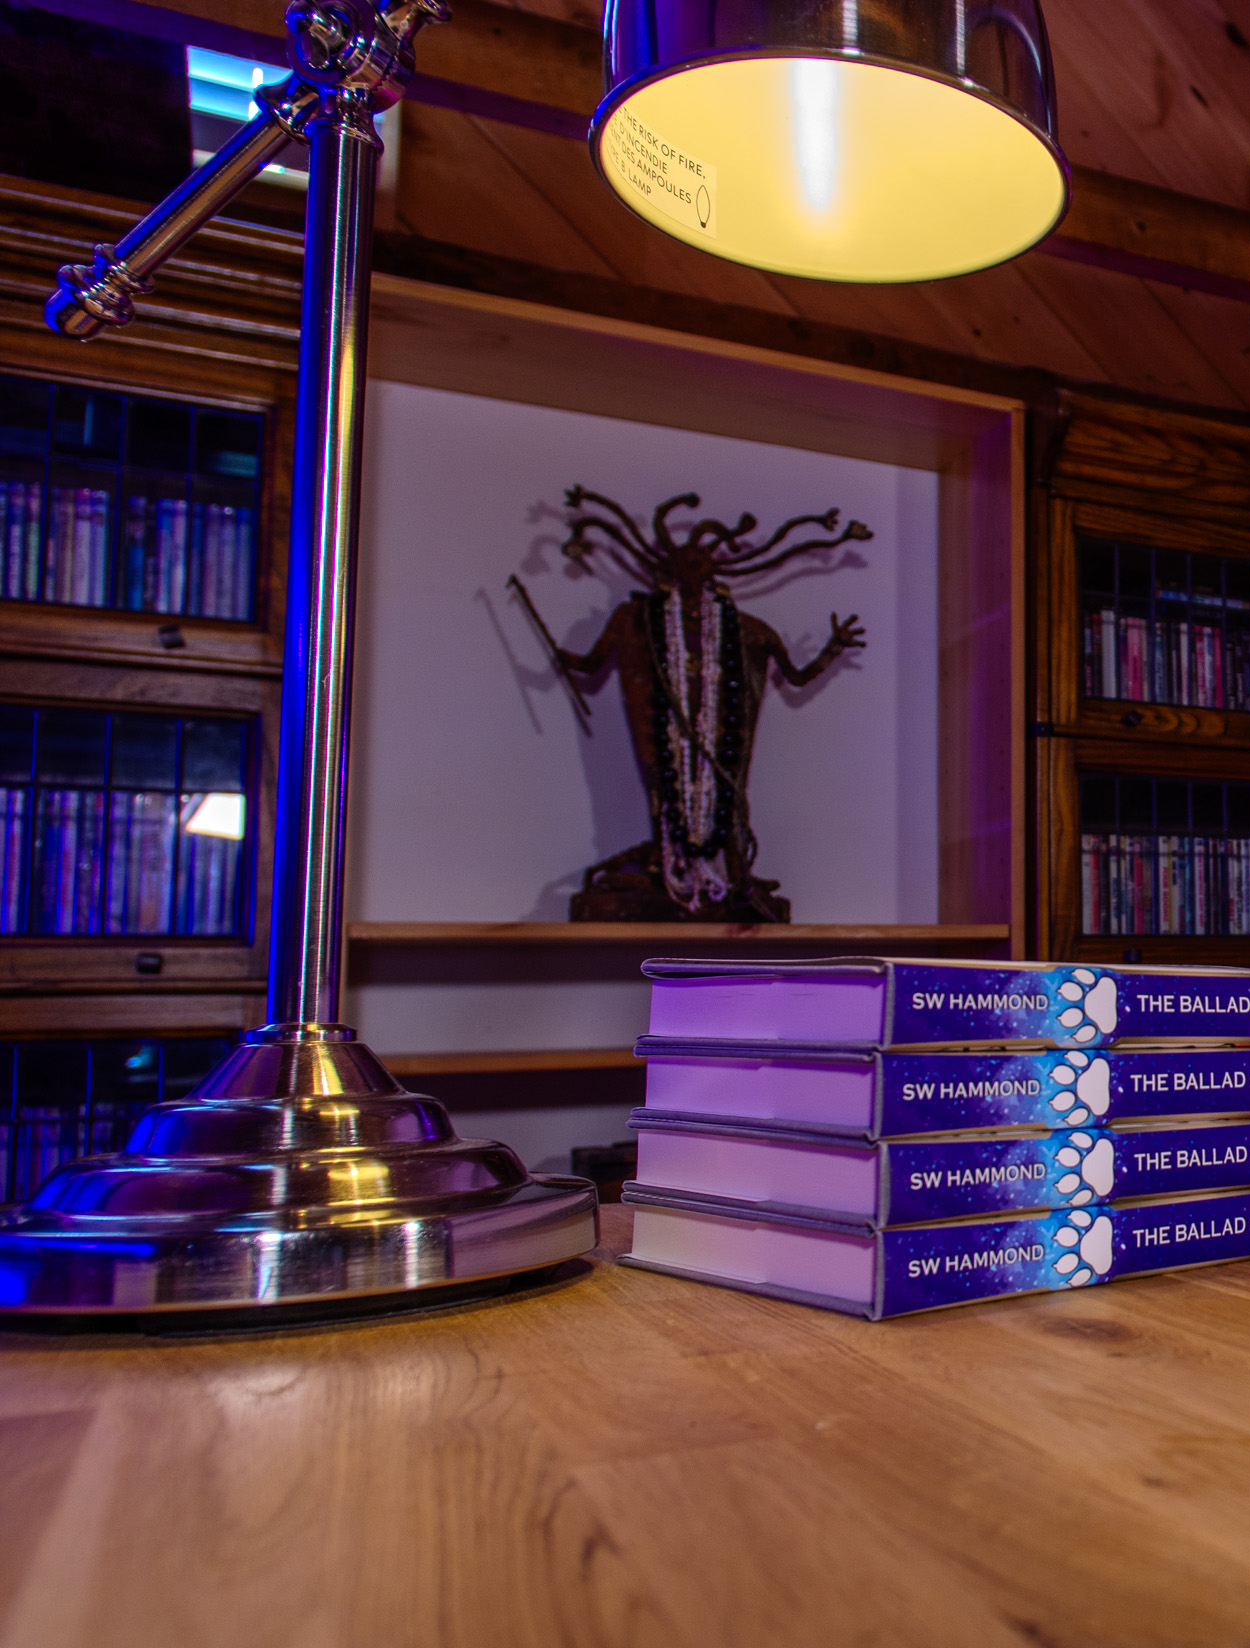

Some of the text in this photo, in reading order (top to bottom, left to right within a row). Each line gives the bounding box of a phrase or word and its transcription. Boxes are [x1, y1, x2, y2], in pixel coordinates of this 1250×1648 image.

[623, 106, 637, 132] THE
[639, 124, 659, 151] RISK
[661, 144, 676, 160] OF
[621, 141, 635, 164] DES
[637, 159, 692, 204] AMPOULES
[628, 168, 652, 196] LAMP
[912, 992, 1049, 1011] SW HAMMOND
[1137, 994, 1175, 1013] THE
[1180, 995, 1250, 1013] BALLAD
[902, 1079, 1041, 1101] SW HAMMOND
[1130, 1073, 1169, 1092] THE
[1173, 1071, 1246, 1091] BALLAD
[1134, 1151, 1172, 1172] THE
[1176, 1146, 1248, 1168] BALLAD
[910, 1163, 1046, 1190] SW HAMMOND
[1132, 1226, 1171, 1248] THE
[1175, 1217, 1246, 1243] BALLAD
[908, 1244, 1045, 1278] SW HAMMOND
